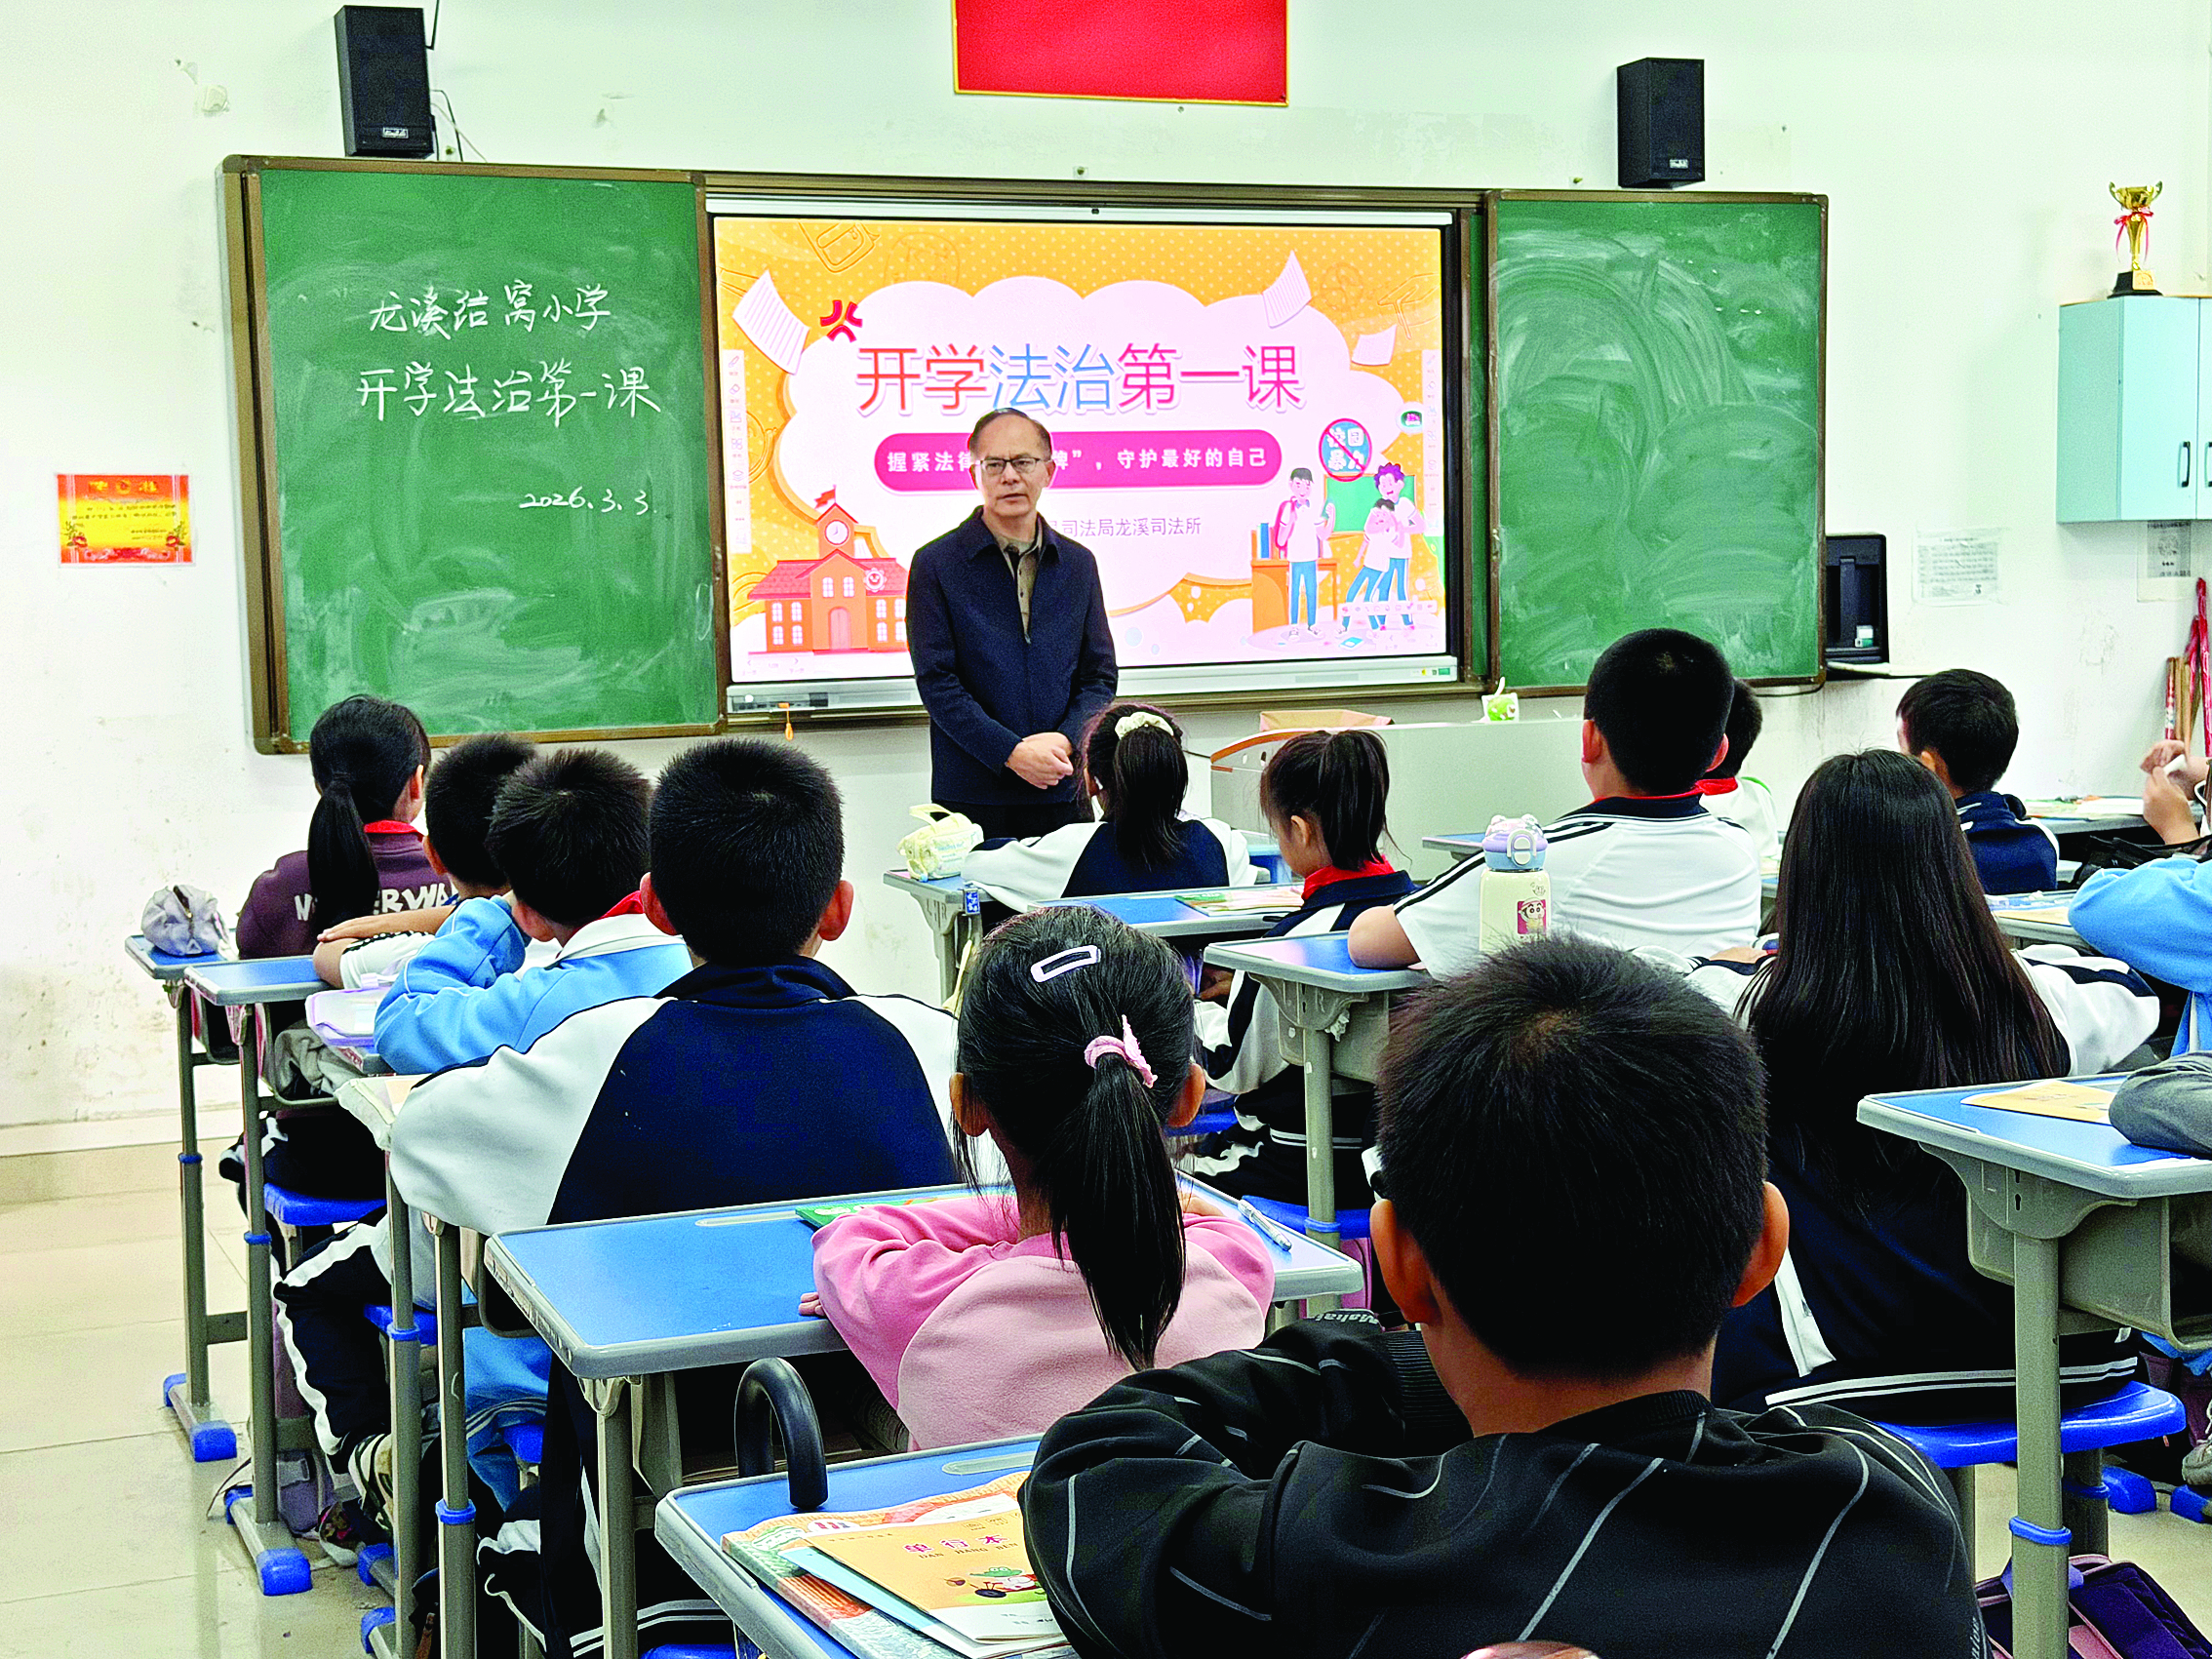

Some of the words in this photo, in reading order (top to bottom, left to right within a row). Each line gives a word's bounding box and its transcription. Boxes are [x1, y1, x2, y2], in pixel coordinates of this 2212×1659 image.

[356, 357, 661, 428] 开学法治第一课
[856, 342, 1302, 412] 开学法治第一课
